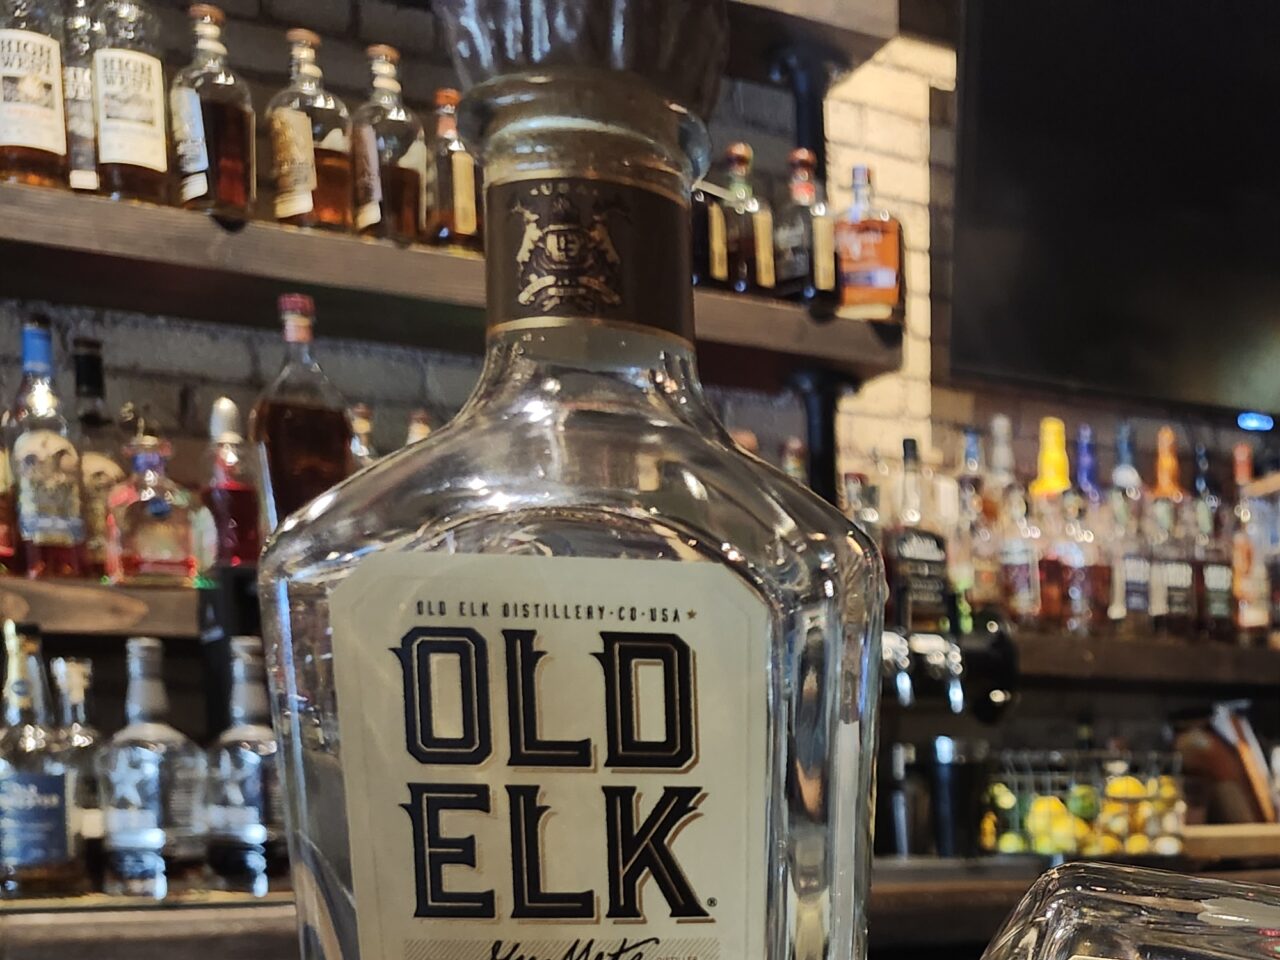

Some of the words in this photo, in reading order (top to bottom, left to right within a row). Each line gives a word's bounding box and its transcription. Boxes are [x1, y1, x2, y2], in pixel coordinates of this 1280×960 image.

[416, 600, 447, 616] OLD
[459, 602, 490, 617] ELK
[388, 626, 702, 773] OLD
[398, 782, 716, 924] ELK
